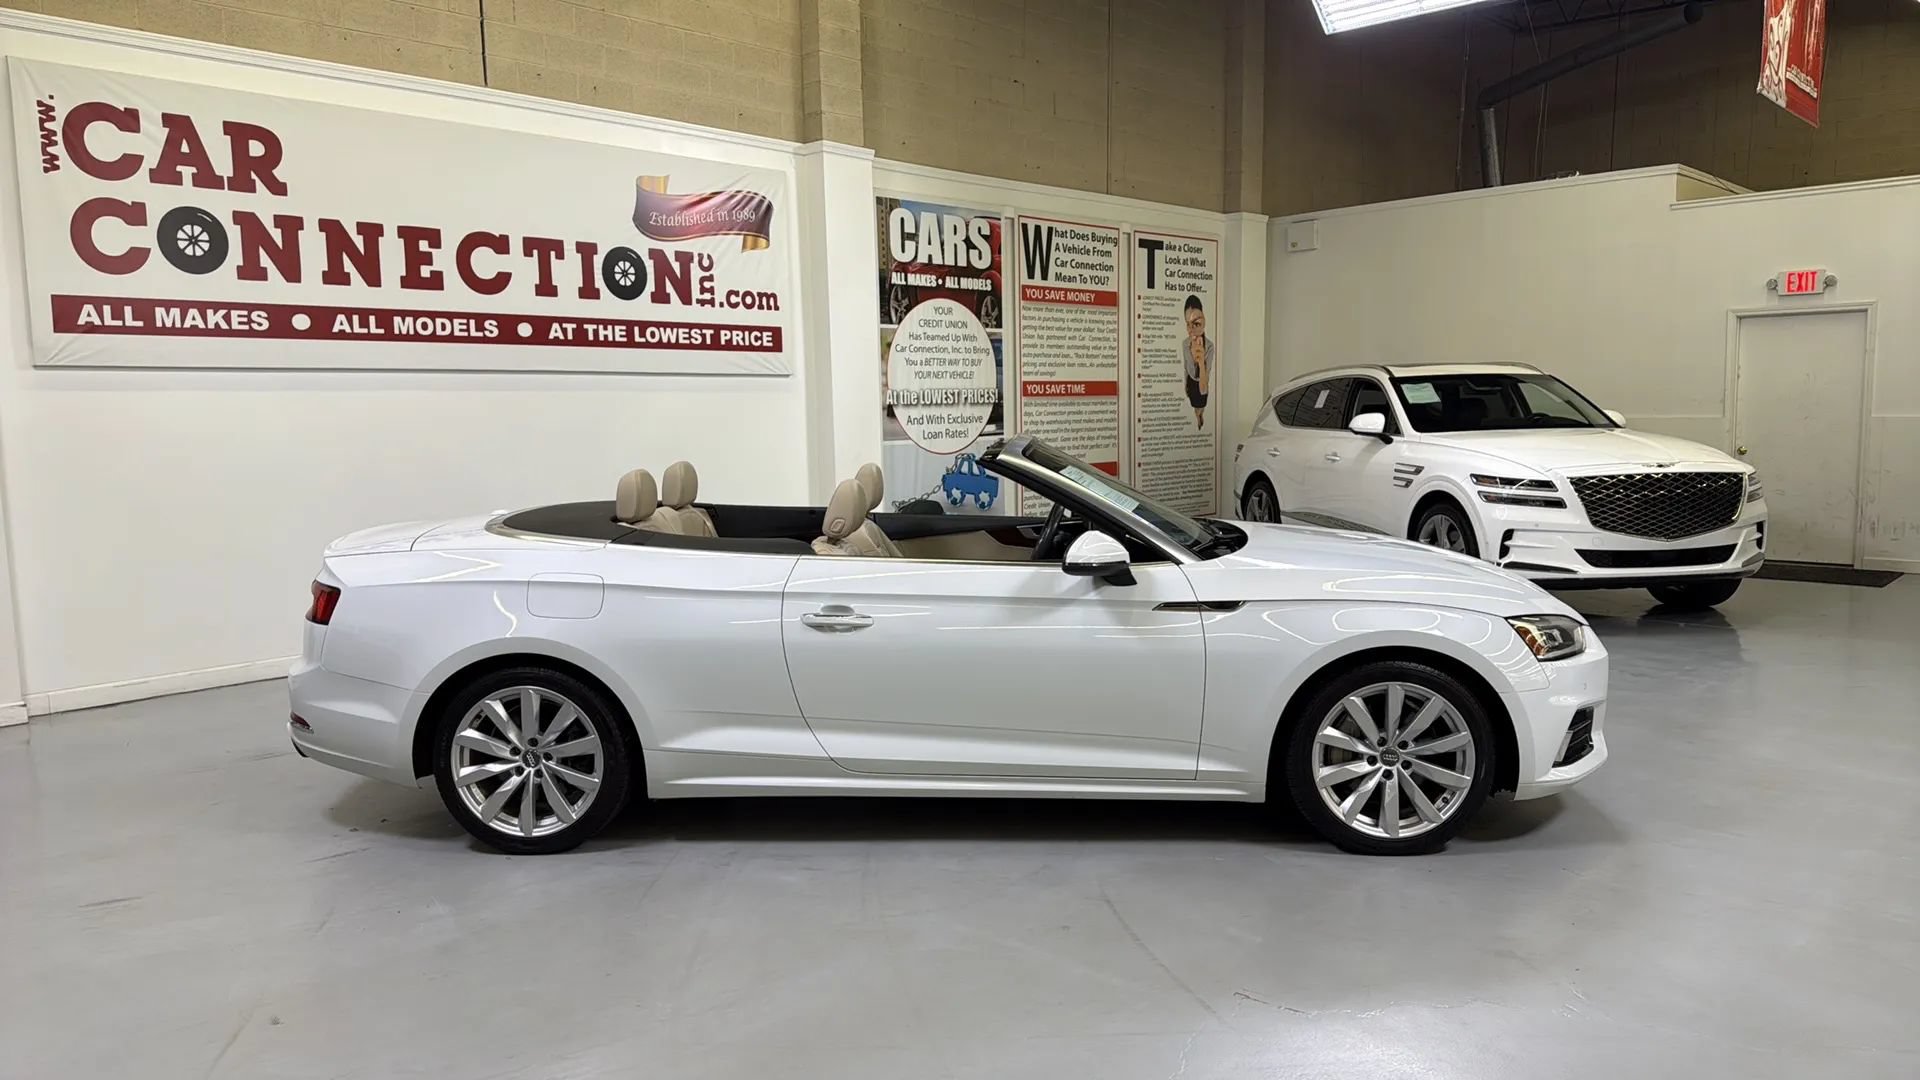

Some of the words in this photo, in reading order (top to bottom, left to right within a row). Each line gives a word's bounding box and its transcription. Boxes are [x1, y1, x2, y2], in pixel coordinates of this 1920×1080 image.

[36, 94, 61, 174] www.
[61, 101, 288, 197] CAR
[648, 205, 715, 227] Established
[717, 206, 729, 221] in
[732, 208, 756, 224] 1989
[889, 207, 992, 270] CARS
[1069, 229, 1090, 242] Does
[1091, 231, 1118, 247] Buying
[1054, 242, 1061, 253] A
[1062, 242, 1091, 256] Vehicle
[1092, 246, 1112, 258] From
[1183, 243, 1204, 254] Closer
[1054, 257, 1069, 268] Car
[1069, 258, 1115, 273] Connection
[1164, 255, 1181, 265] Look
[1182, 257, 1189, 266] at
[1189, 257, 1206, 267] What
[891, 271, 906, 285] ALL
[907, 272, 937, 288] MAKES
[1054, 271, 1078, 284] Mean
[1078, 274, 1088, 284] To
[1089, 275, 1110, 287] YOU?
[1164, 268, 1176, 278] Car
[1177, 269, 1213, 280] Connection
[1787, 271, 1817, 293] EXIT
[944, 276, 960, 289] ALL
[960, 277, 992, 292] MODELS
[1164, 281, 1177, 291] Has
[1186, 283, 1207, 293] Offer...
[718, 288, 780, 312] .com
[1025, 287, 1044, 299] YOU
[1044, 289, 1066, 301] SAVE
[1066, 290, 1096, 303] MONEY
[77, 304, 144, 327] ALL
[154, 307, 270, 332] MAKES
[933, 306, 954, 316] YOUR
[331, 313, 385, 335] ALL
[392, 315, 500, 338] MODELS
[918, 318, 943, 329] CREDIT
[944, 320, 968, 329] UNION
[548, 323, 577, 341] AT
[583, 325, 628, 343] THE
[633, 326, 715, 346] LOWEST
[719, 330, 774, 348] PRICE
[908, 332, 922, 341] Has
[922, 332, 950, 342] Teamed
[951, 334, 961, 343] Up
[961, 334, 978, 343] With
[894, 344, 907, 353] Car
[972, 346, 991, 357] Bring
[904, 357, 918, 367] You
[924, 357, 946, 367] BETTER
[947, 358, 961, 366] WAY
[961, 358, 971, 367] TO
[970, 358, 983, 367] BUY
[913, 370, 932, 380] YOUR
[932, 371, 948, 380] NEXT
[886, 389, 899, 405] At
[899, 389, 919, 406] the
[920, 388, 960, 406] LOWEST
[961, 387, 999, 404] PRICES!
[1026, 384, 1044, 394] YOU
[1045, 384, 1066, 394] SAVE
[1066, 384, 1086, 394] TIME
[906, 414, 924, 426] And
[926, 414, 946, 425] With
[947, 412, 983, 424] Exclusive
[922, 428, 944, 440] Loan
[945, 427, 969, 439] Rates!
